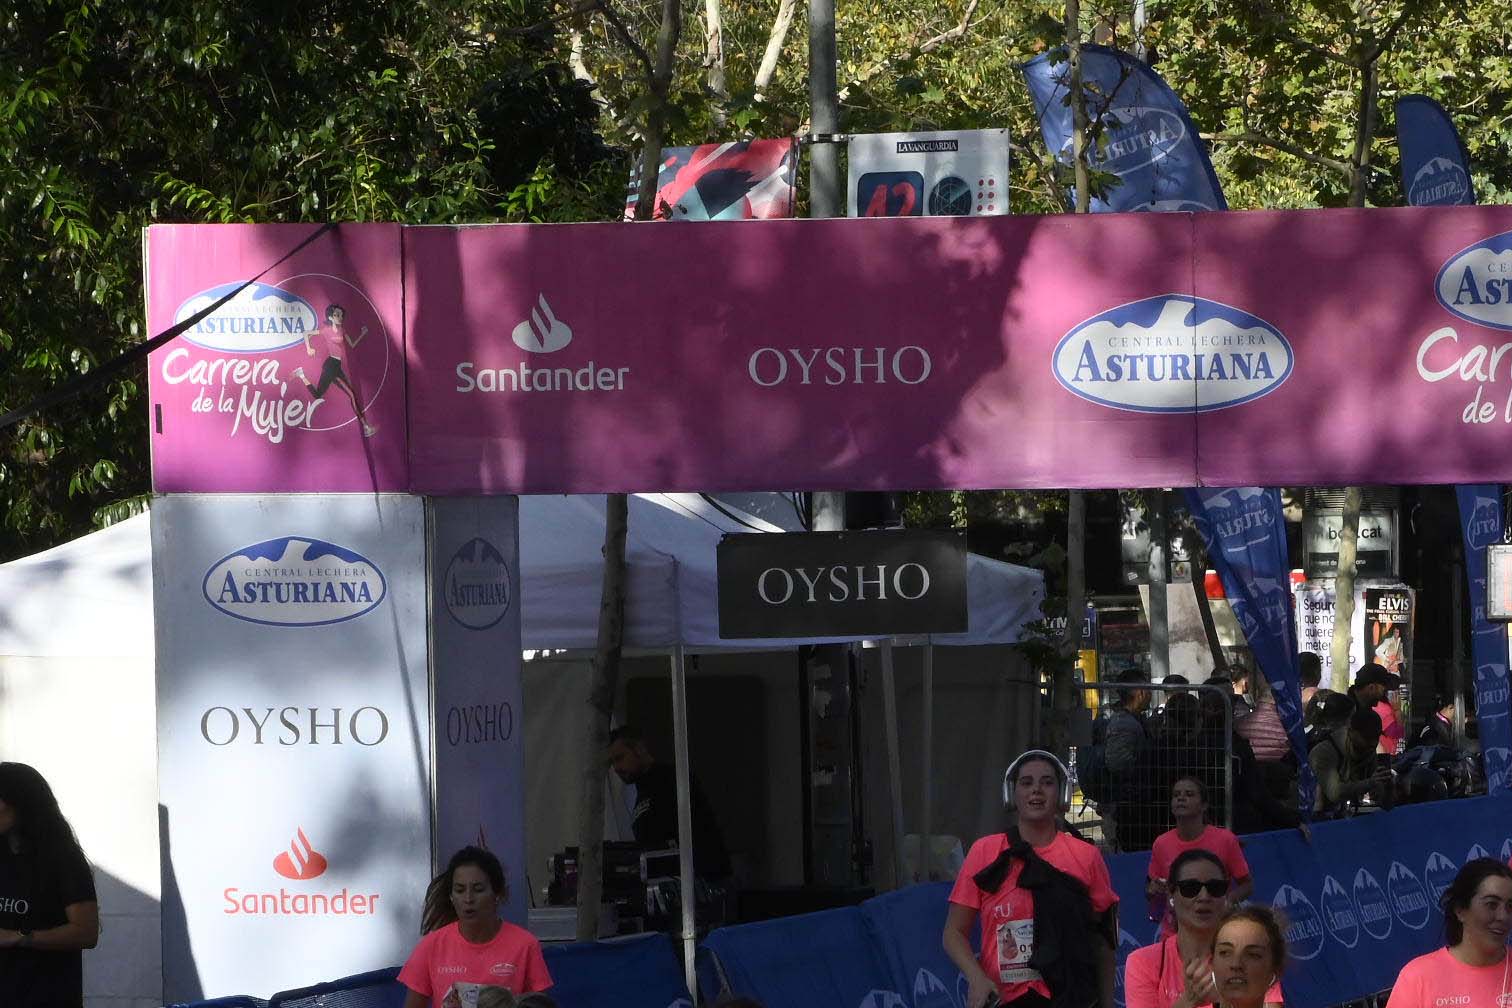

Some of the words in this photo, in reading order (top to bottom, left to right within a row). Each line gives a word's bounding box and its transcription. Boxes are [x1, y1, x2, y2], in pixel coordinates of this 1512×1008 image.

[1108, 335, 1184, 348] CENTRAL
[1190, 334, 1267, 347] LECHERA
[162, 347, 280, 384] Carrera
[456, 360, 630, 393] Santander
[747, 345, 932, 387] OYSHO
[1071, 339, 1275, 382] ASTURIANA
[191, 386, 214, 413] de
[217, 386, 234, 413] la
[231, 381, 325, 443] Mujer
[1462, 386, 1496, 424] de
[217, 570, 374, 603] ASTURIANA
[245, 567, 303, 577] CENTRAL
[308, 567, 367, 577] LECHERA
[757, 563, 930, 606] OYSHO
[450, 573, 507, 607] ASTURIANA
[1378, 598, 1409, 611] ELVIS
[200, 705, 389, 746] OYSHO
[446, 701, 513, 746] OYSHO
[223, 887, 380, 916] Santander
[1436, 995, 1470, 1007] OYSHO
